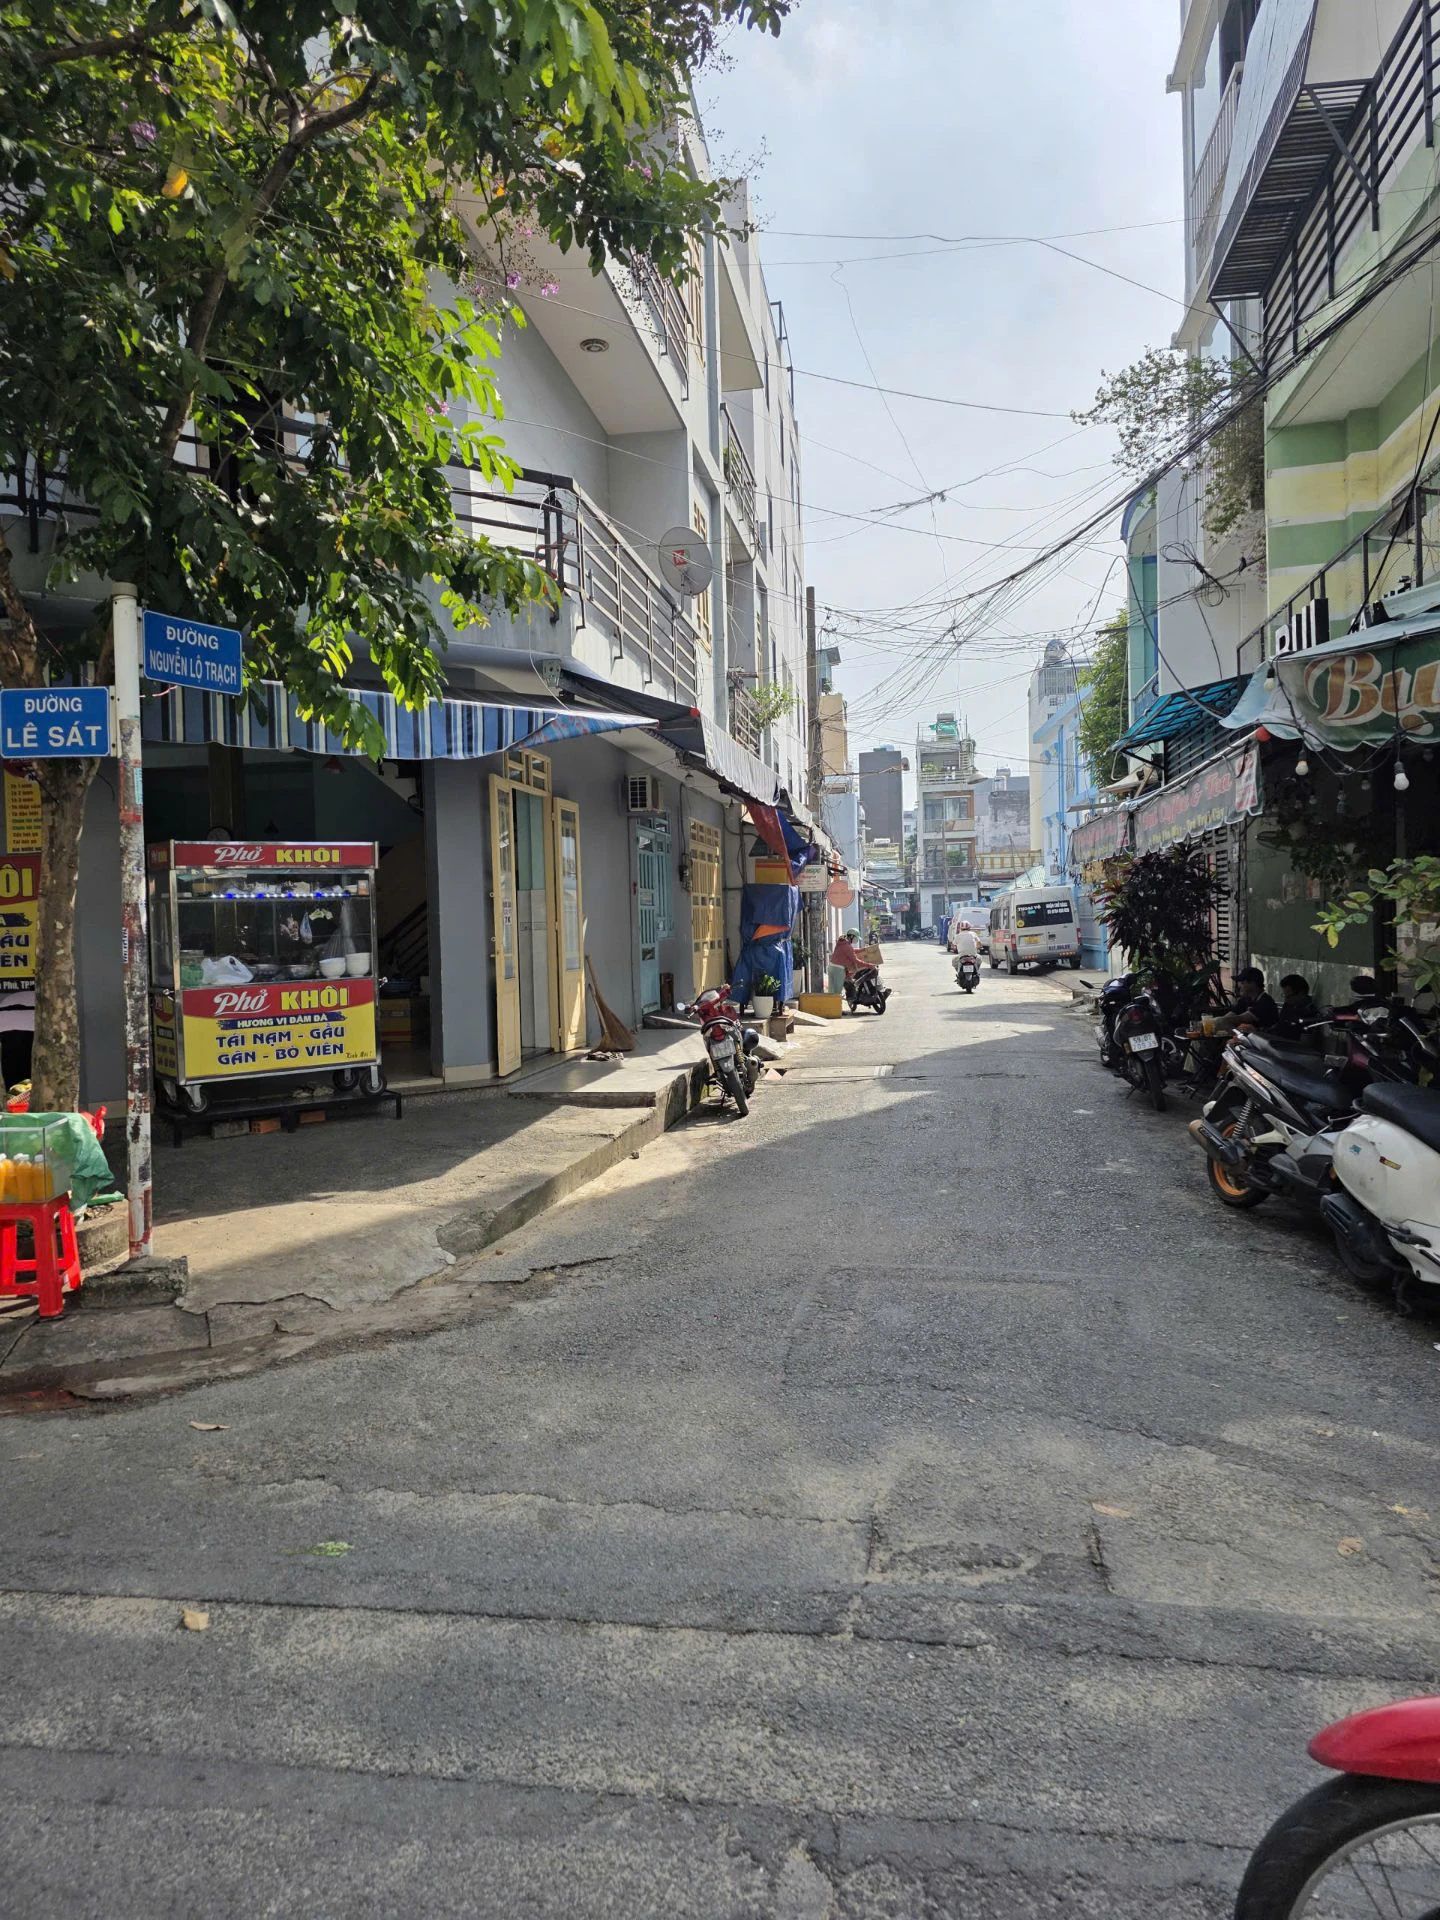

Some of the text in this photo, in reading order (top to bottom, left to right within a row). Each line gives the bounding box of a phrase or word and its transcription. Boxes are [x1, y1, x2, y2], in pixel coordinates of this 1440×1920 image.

[166, 626, 219, 650] ĐƯỜNG
[149, 646, 188, 676] NGUYỄN
[204, 659, 237, 686] TRẠCH
[24, 694, 82, 713] ĐƯỜNG
[7, 720, 102, 748] LÊ SÁT
[214, 846, 340, 863] Phở KHÔI
[213, 986, 348, 1016] Phở KHÔI
[216, 1032, 245, 1048] TÁI
[253, 1030, 291, 1047] NẠM
[276, 1045, 299, 1060] BÒ
[306, 1042, 344, 1057] VIÊN
